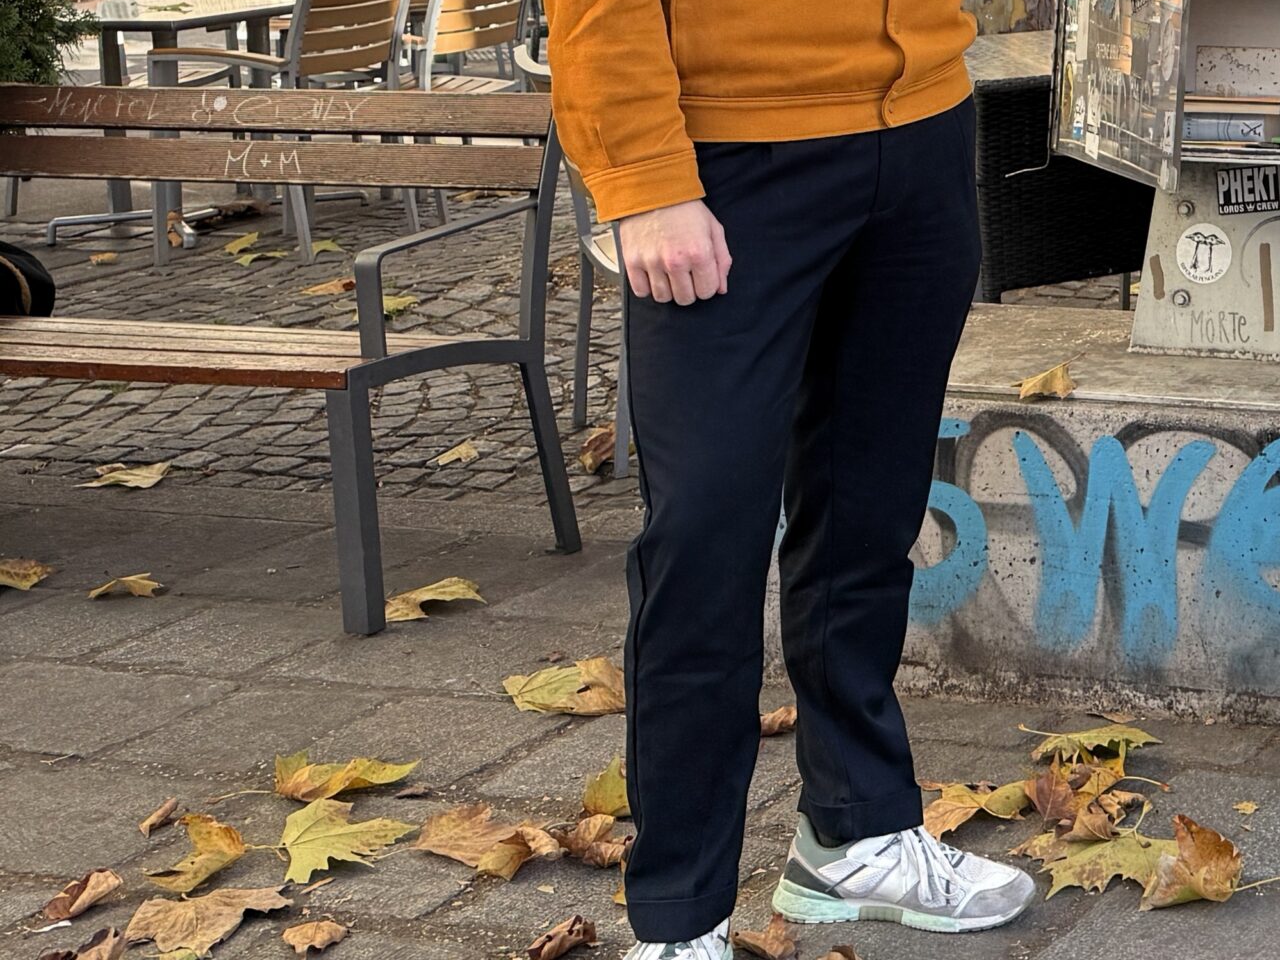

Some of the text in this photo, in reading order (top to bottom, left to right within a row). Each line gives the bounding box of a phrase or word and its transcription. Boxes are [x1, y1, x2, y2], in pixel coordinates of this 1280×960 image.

[1217, 166, 1276, 204] PHEKT
[1219, 201, 1279, 214] LORDS CREW
